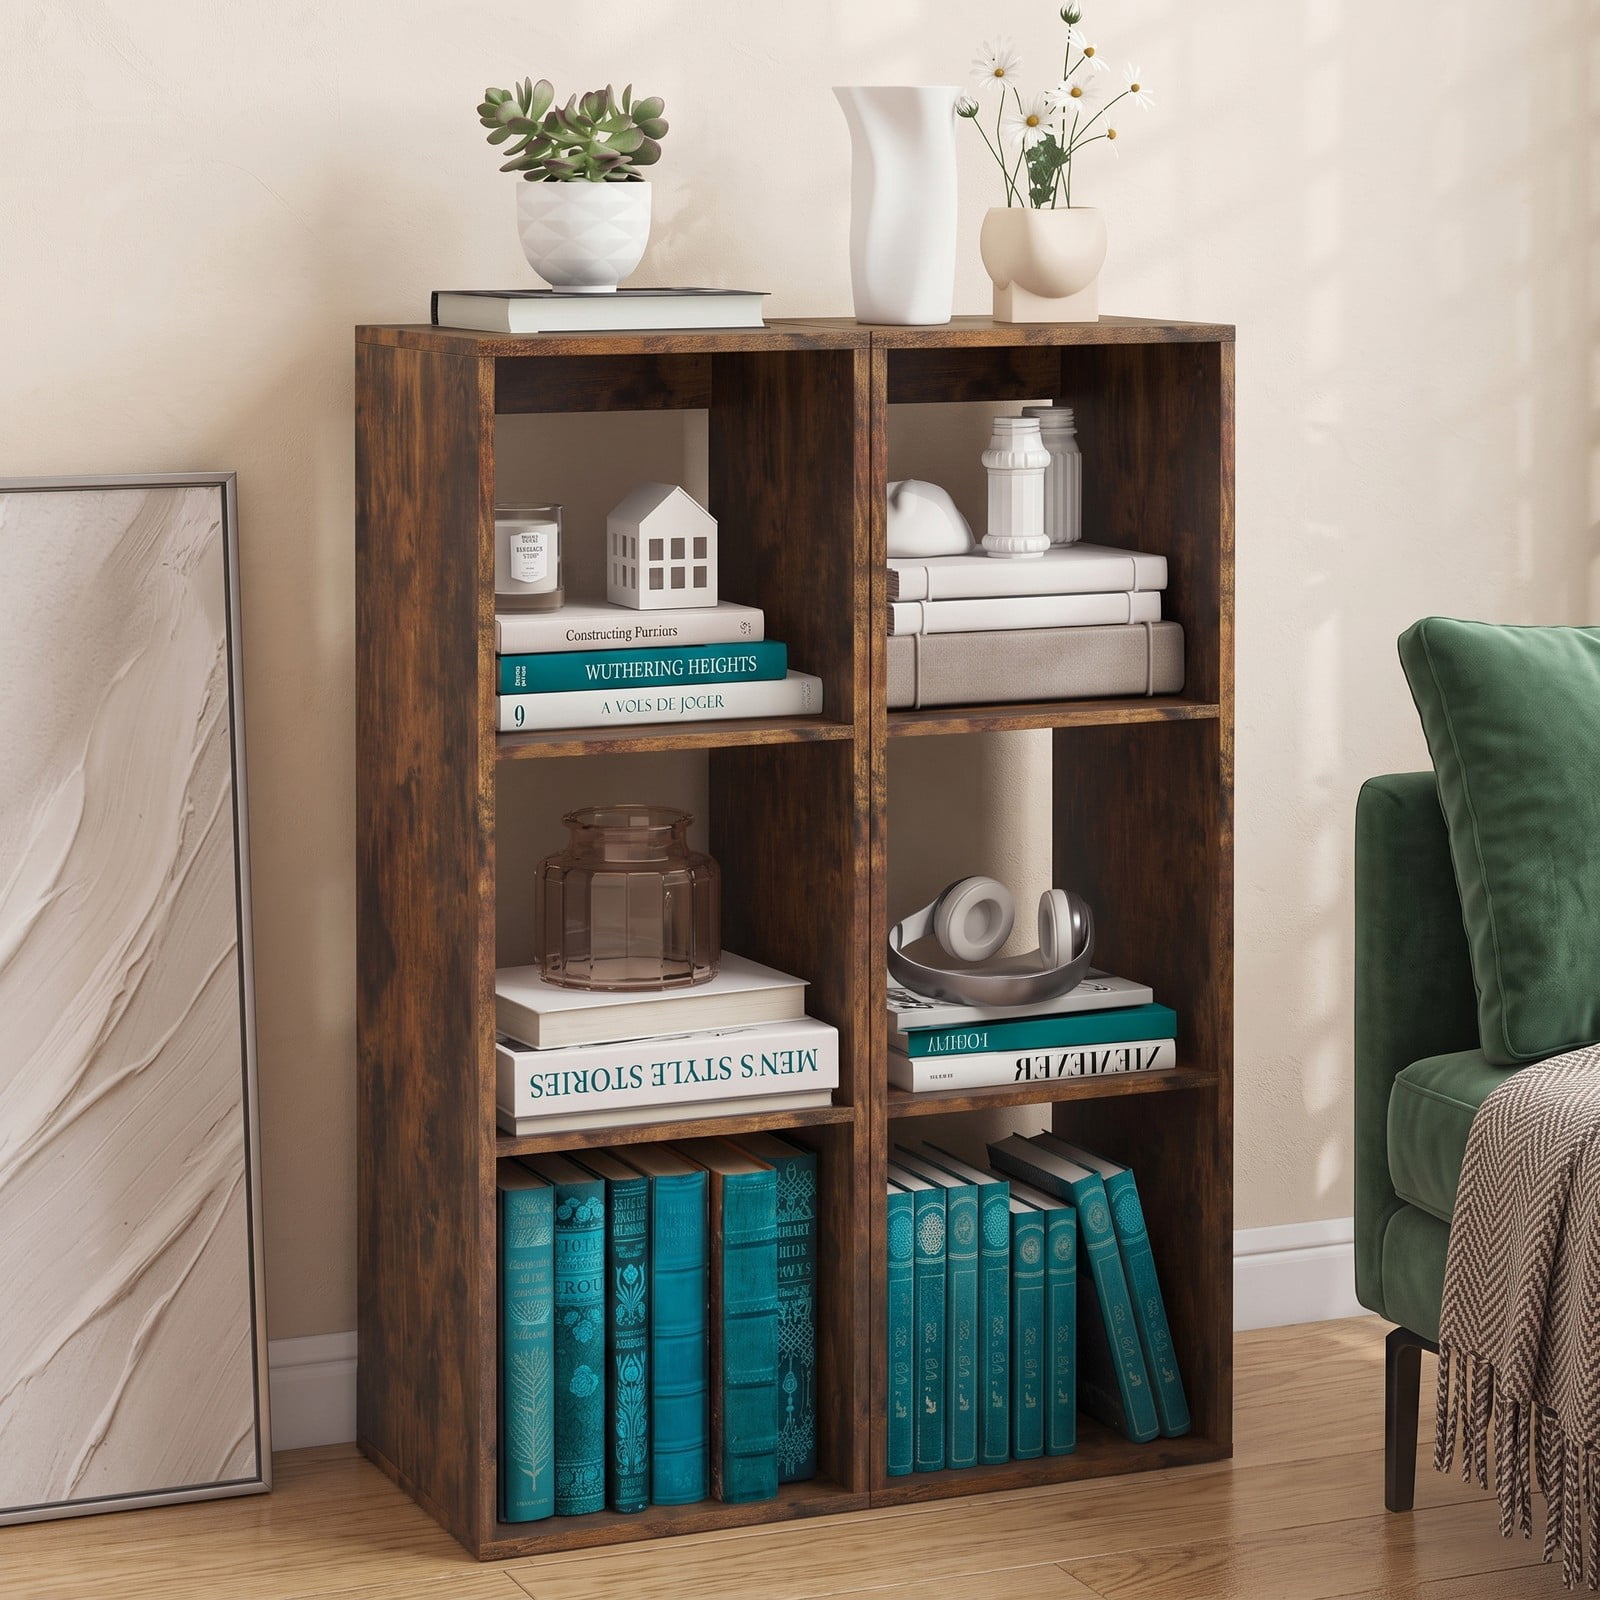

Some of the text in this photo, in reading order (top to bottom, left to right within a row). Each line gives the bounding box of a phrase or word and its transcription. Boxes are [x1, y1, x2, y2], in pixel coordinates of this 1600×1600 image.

[565, 626, 632, 642] Constructing
[585, 655, 757, 681] WUTHERING HEIGHTS
[514, 704, 525, 728] 9
[601, 701, 611, 714] A
[657, 697, 677, 712] DE
[680, 694, 725, 714] JOGER
[530, 1048, 819, 1099] MEN'S STYLE STORIES
